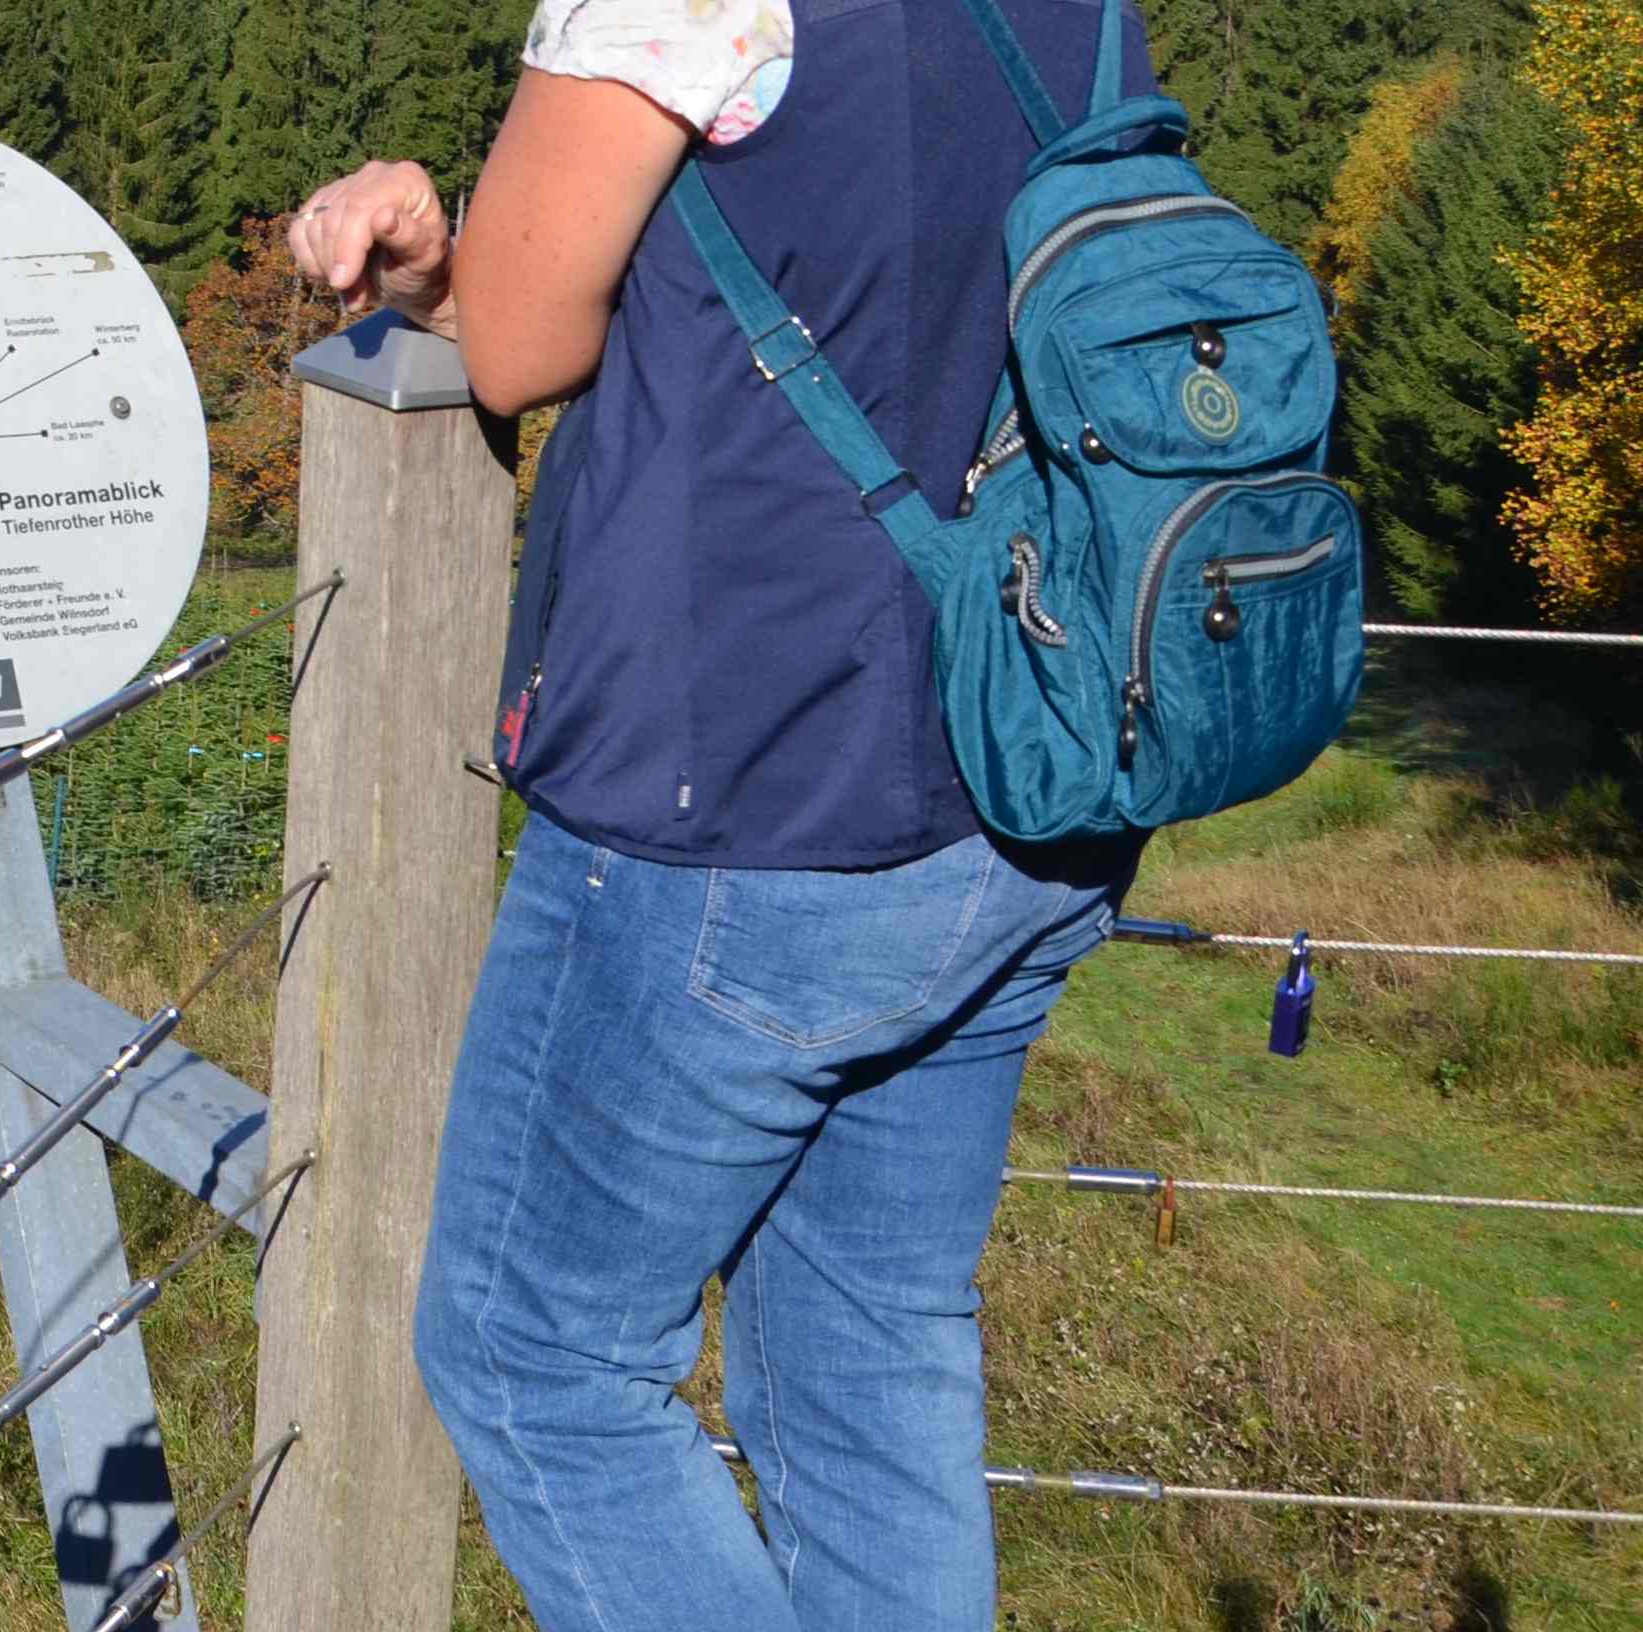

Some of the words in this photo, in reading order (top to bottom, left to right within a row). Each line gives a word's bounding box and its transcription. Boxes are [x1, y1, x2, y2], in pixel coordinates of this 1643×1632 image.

[2, 510, 105, 535] Tiefenrother
[110, 508, 154, 526] Höhe
[57, 591, 102, 605] Freunde
[0, 612, 55, 627] Gemeinde
[58, 606, 110, 620] Wilnsdorf
[2, 627, 59, 642] Volksbank
[63, 621, 120, 637] Siegerland
